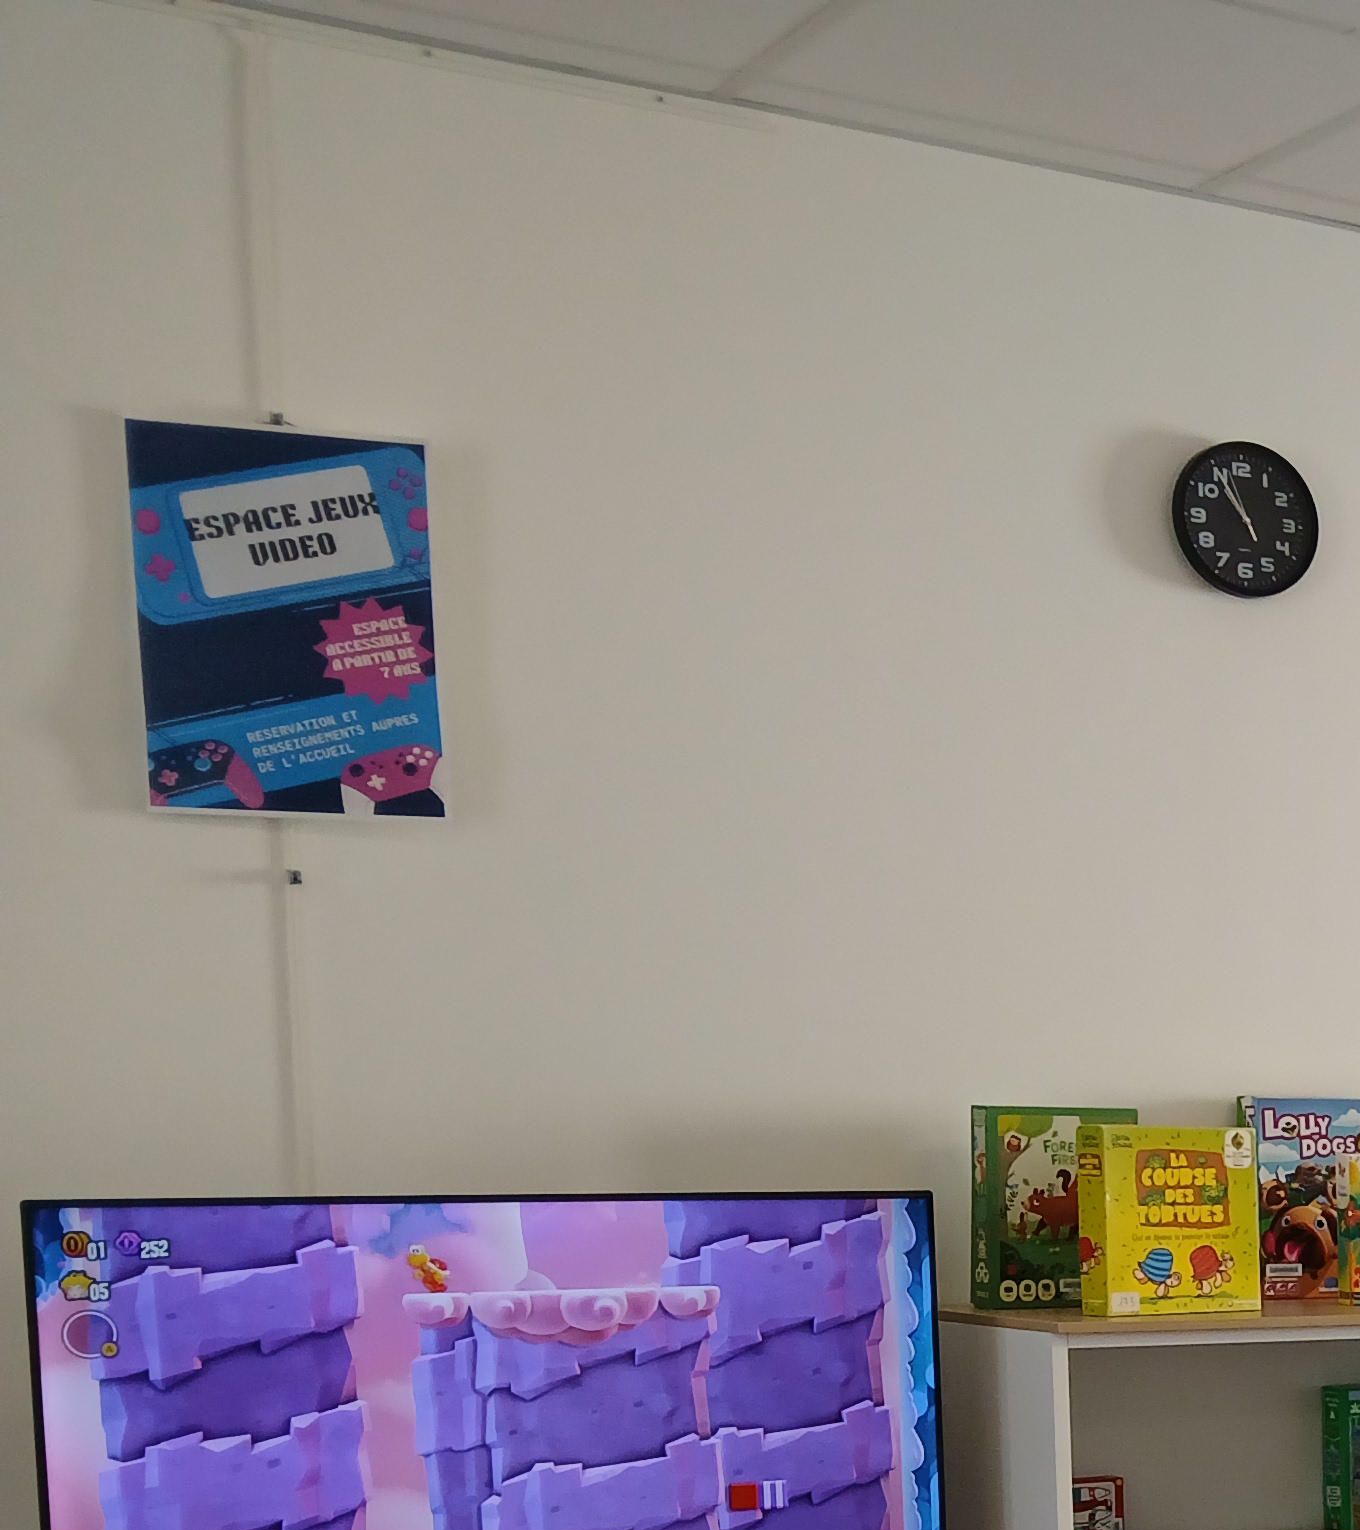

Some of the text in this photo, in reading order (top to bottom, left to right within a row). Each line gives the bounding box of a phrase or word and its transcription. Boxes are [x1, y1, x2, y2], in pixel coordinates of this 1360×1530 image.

[1231, 462, 1252, 478] 12
[1262, 472, 1269, 488] 1
[1198, 482, 1219, 498] 10
[1274, 491, 1288, 507] 2
[184, 492, 381, 542] ESPACE JEUX
[1190, 507, 1207, 523] 9
[1282, 518, 1296, 533] 3
[1198, 531, 1215, 548] 8
[1275, 540, 1290, 556] 4
[248, 532, 337, 567] VIDEO
[1215, 552, 1230, 568] 7
[1260, 557, 1275, 572] 5
[1237, 562, 1254, 578] 6
[352, 616, 406, 636] ESPACE
[325, 631, 412, 656] ACCESSIBLE
[344, 651, 396, 670] PARTIR
[246, 710, 357, 743] RESERVATION ET
[252, 713, 418, 758] RENSEIGNEMENTS AUPRES
[257, 744, 355, 773] DE L'ACCUEIL
[1301, 1137, 1357, 1157] DOGS
[1170, 1152, 1188, 1167] LA
[1141, 1167, 1217, 1187] COURSE
[1165, 1188, 1195, 1204] DES
[1137, 1203, 1225, 1225] TORTUES
[87, 1240, 170, 1260] 01 252
[89, 1283, 109, 1301] 05
